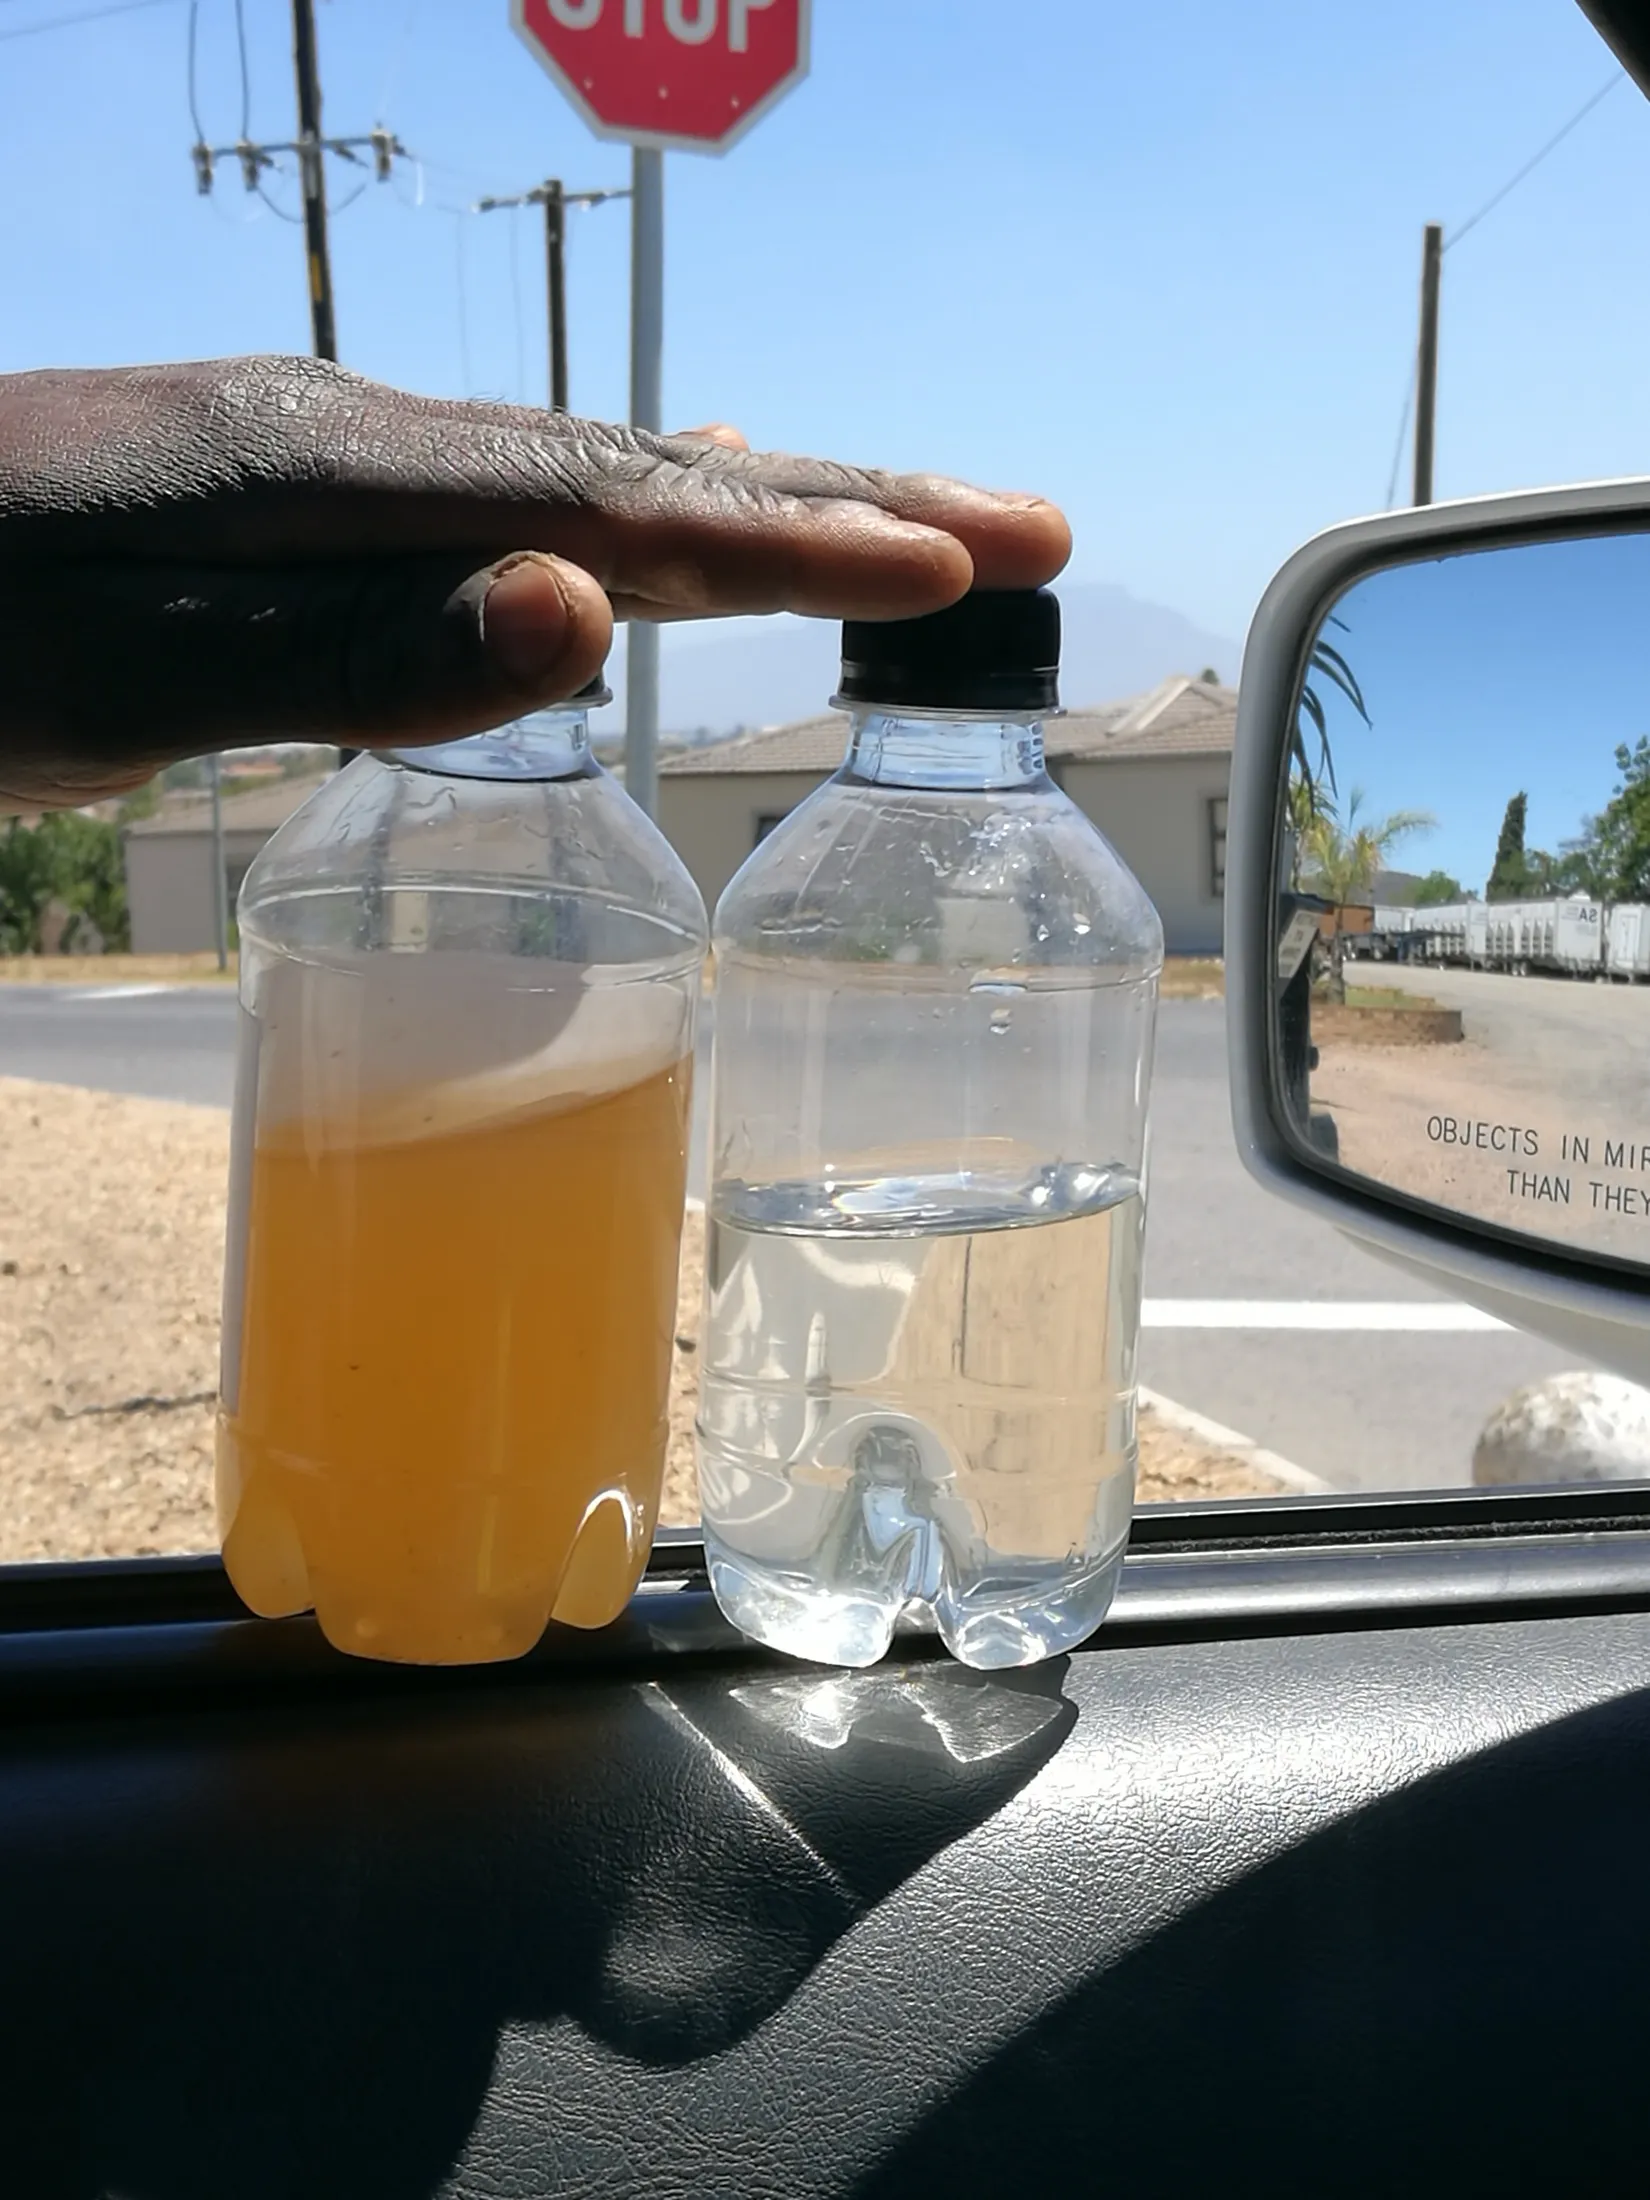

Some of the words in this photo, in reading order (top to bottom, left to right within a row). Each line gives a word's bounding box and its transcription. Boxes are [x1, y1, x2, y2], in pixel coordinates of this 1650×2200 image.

[1427, 1116, 1539, 1156] OBJECTS
[1562, 1134, 1589, 1164] IN
[1507, 1169, 1570, 1204] THAN
[1589, 1181, 1650, 1216] THEY
